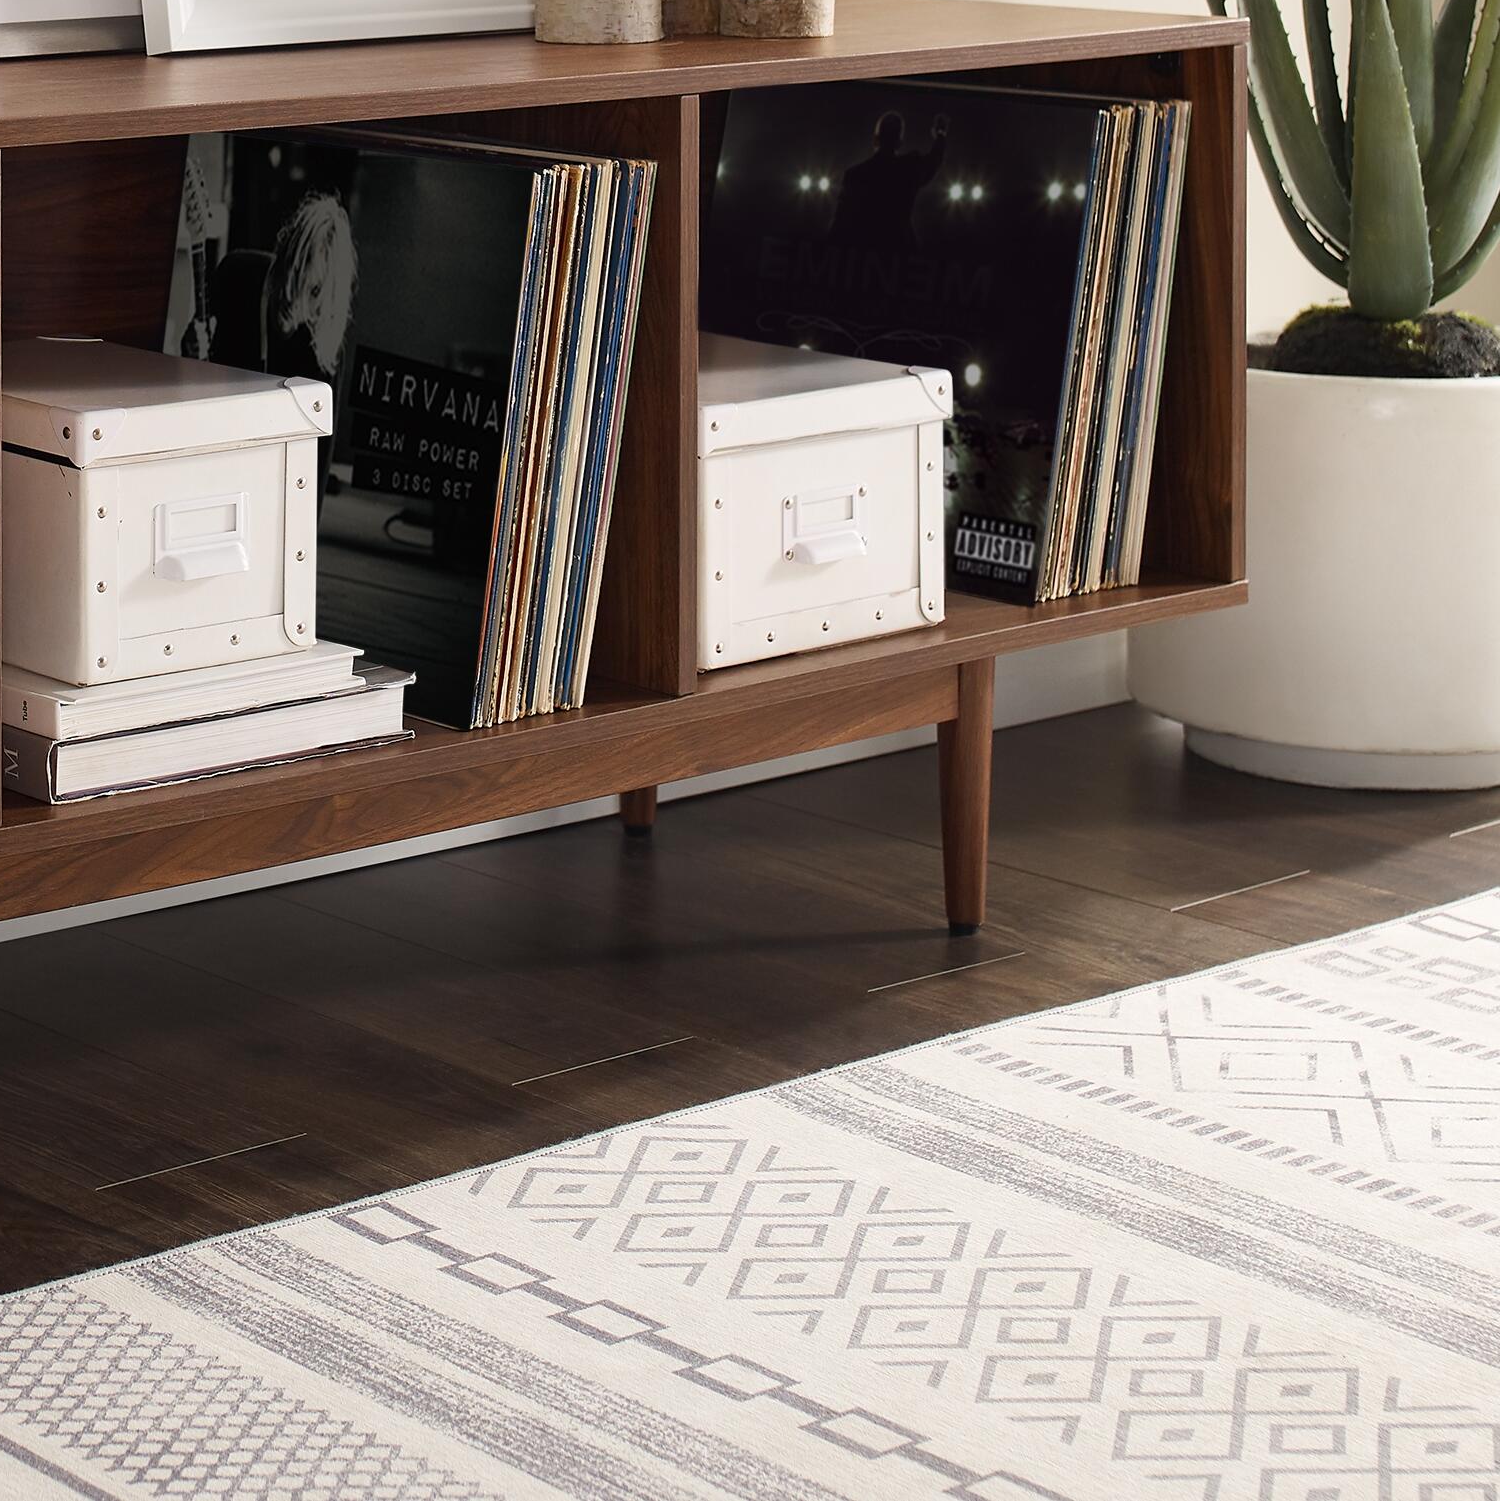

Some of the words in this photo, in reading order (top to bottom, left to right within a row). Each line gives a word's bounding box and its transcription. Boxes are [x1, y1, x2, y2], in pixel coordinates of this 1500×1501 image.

[360, 363, 499, 434] NIRVANA
[369, 427, 406, 452] RAW
[418, 439, 480, 471] POWER
[372, 468, 381, 485] 3
[391, 472, 431, 493] DISC
[442, 479, 473, 500] SET
[956, 530, 1034, 568] ADVISORY
